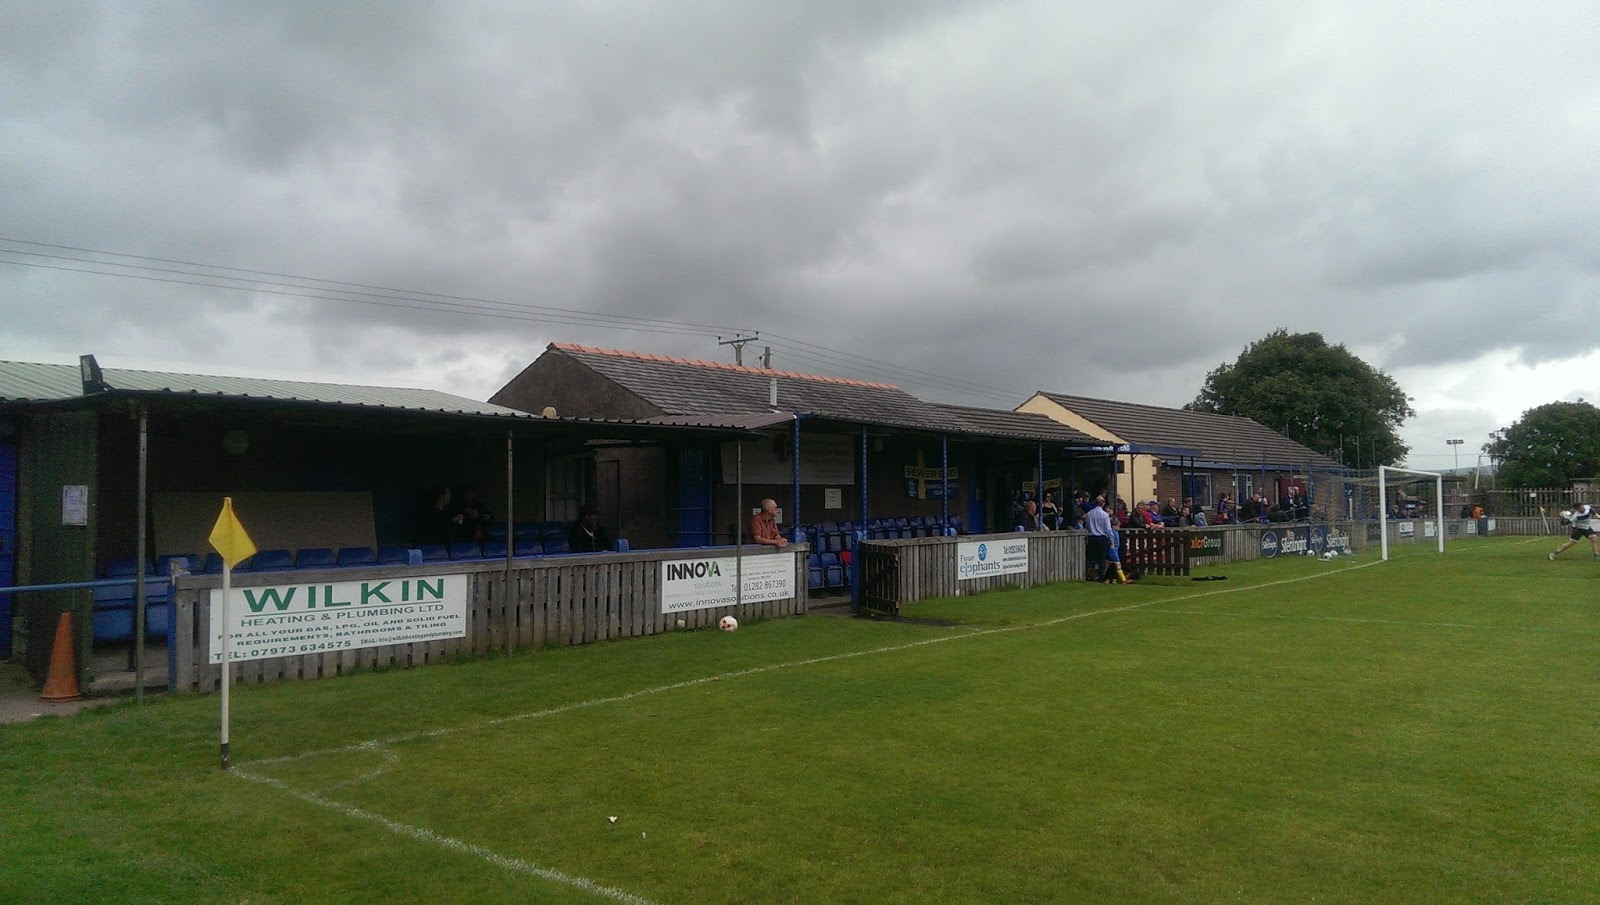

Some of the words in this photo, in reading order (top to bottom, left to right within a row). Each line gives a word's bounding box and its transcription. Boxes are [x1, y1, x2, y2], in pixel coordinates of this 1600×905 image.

[906, 467, 938, 479] SEWER
[960, 554, 975, 563] Four
[667, 561, 721, 581] INNOVA
[959, 561, 1001, 577] elephants
[694, 580, 722, 590] solutions
[743, 581, 763, 592] 01282
[241, 578, 445, 613] WILKIN
[240, 614, 317, 628] HEATING
[320, 612, 332, 621] &
[336, 606, 415, 620] PLUMBING
[419, 604, 444, 614] LTD
[236, 633, 334, 647] REQUIREMENTS,
[335, 626, 403, 638] BATHROOMS
[415, 622, 447, 630] TILING
[270, 628, 304, 636] YOUR
[306, 625, 333, 633] GAS,
[335, 623, 361, 631] LPG,
[250, 645, 297, 658] 07973
[299, 639, 352, 653] 634575
